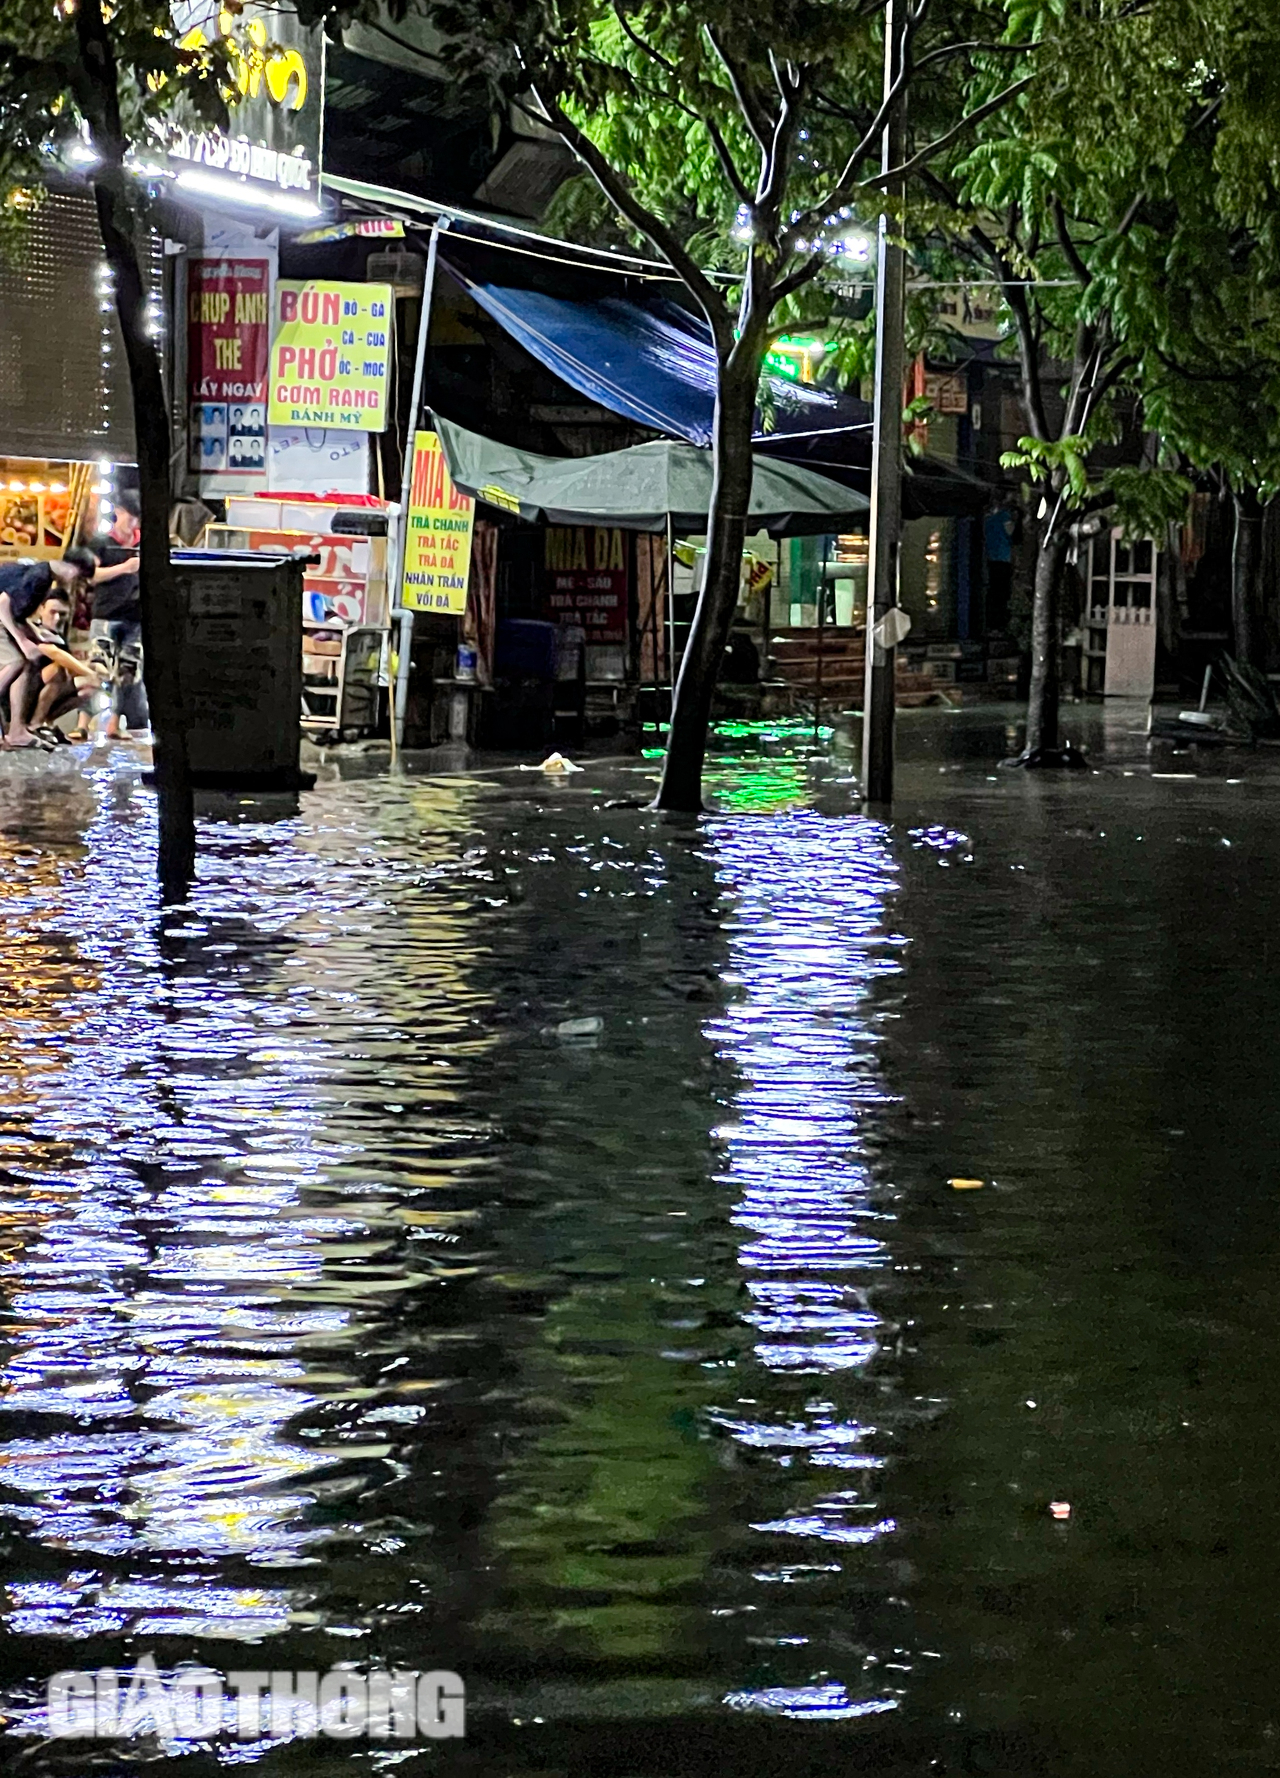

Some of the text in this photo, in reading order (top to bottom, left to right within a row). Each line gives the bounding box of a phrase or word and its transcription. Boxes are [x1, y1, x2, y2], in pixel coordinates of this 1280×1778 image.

[235, 282, 267, 324] ẢNH
[280, 285, 384, 325] BÚN BÒ GÀ
[366, 332, 385, 347] CUA
[278, 338, 338, 381] PHỞ
[222, 382, 262, 397] NGAY
[276, 384, 379, 409] CƠM RANG
[291, 408, 334, 423] BÁNH
[411, 515, 469, 533] TRÀ CHANH
[417, 534, 436, 549] TRÀ
[418, 553, 437, 568] TRÀ
[405, 571, 434, 586] NHÂN
